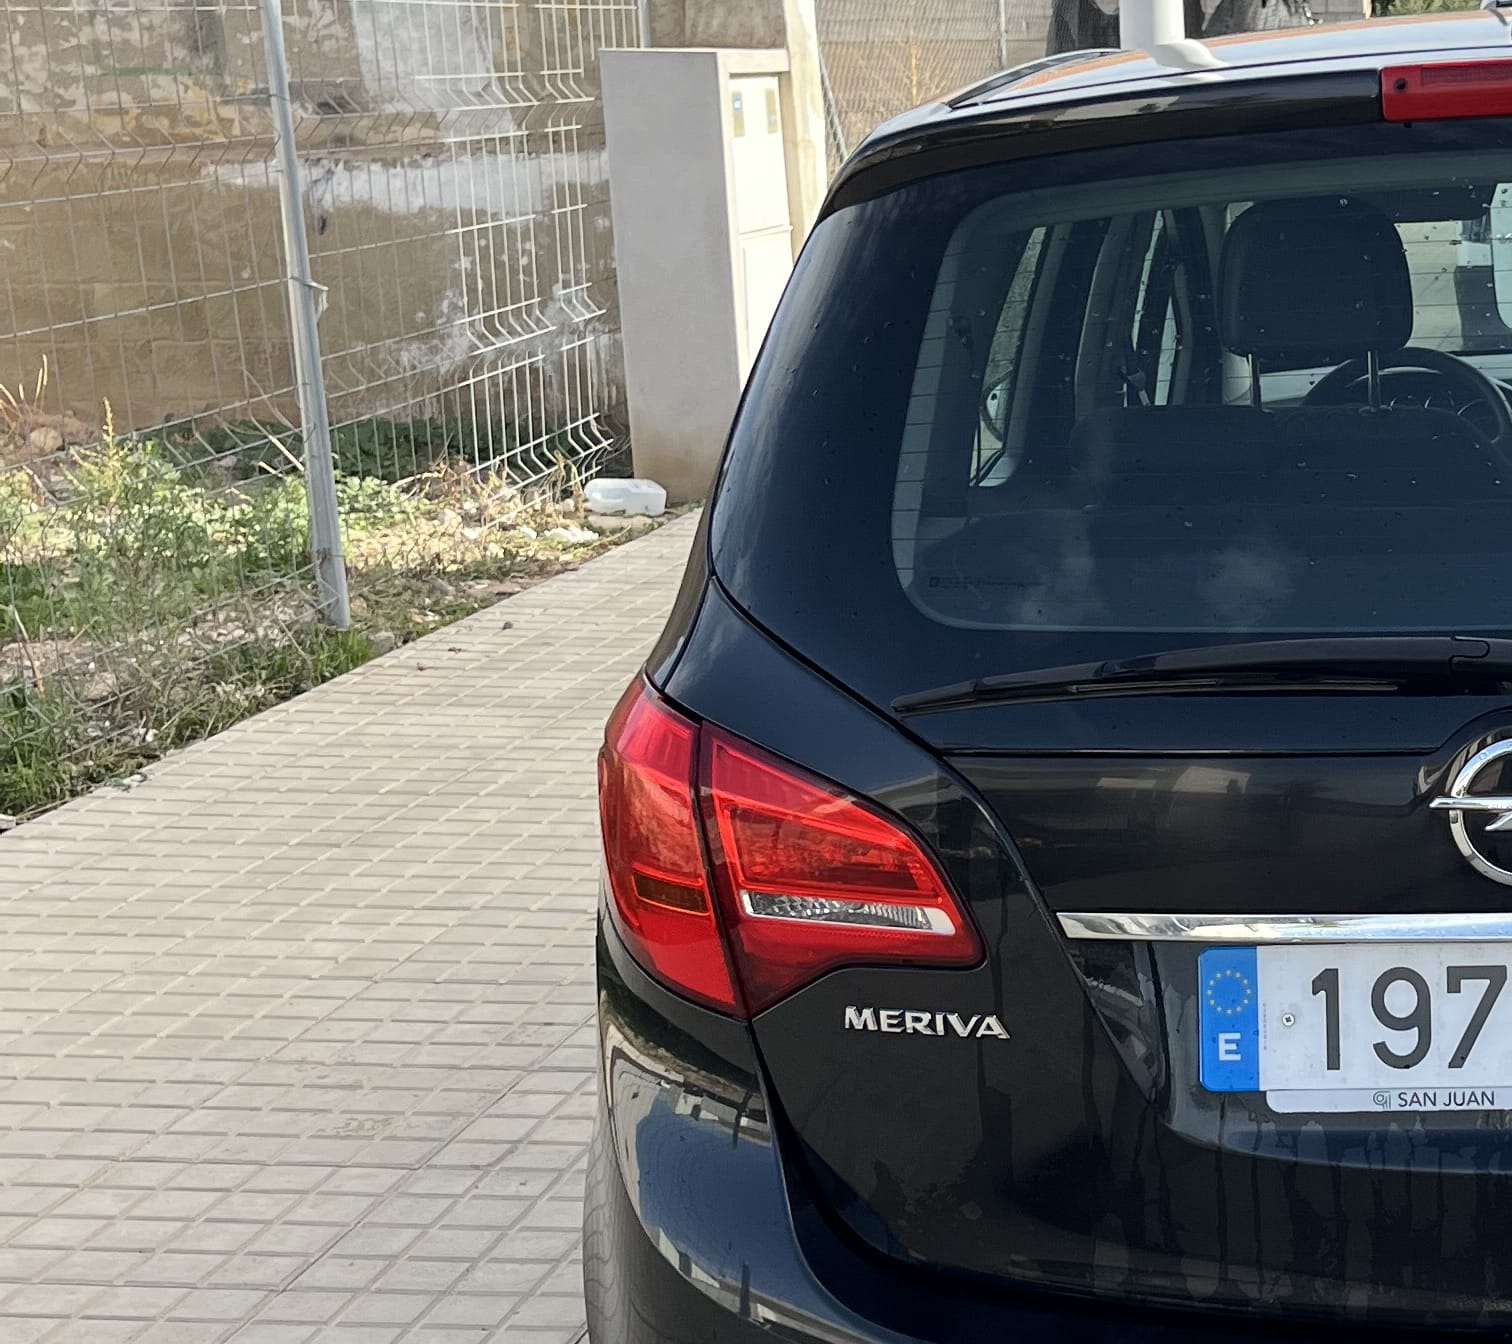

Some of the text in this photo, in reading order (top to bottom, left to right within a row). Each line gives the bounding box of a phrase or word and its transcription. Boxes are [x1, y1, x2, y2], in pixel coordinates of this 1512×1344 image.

[845, 1006, 1011, 1039] MERIVA
[1219, 1032, 1241, 1061] E
[1398, 1092, 1437, 1107] SAN
[1443, 1091, 1495, 1106] JUAN
